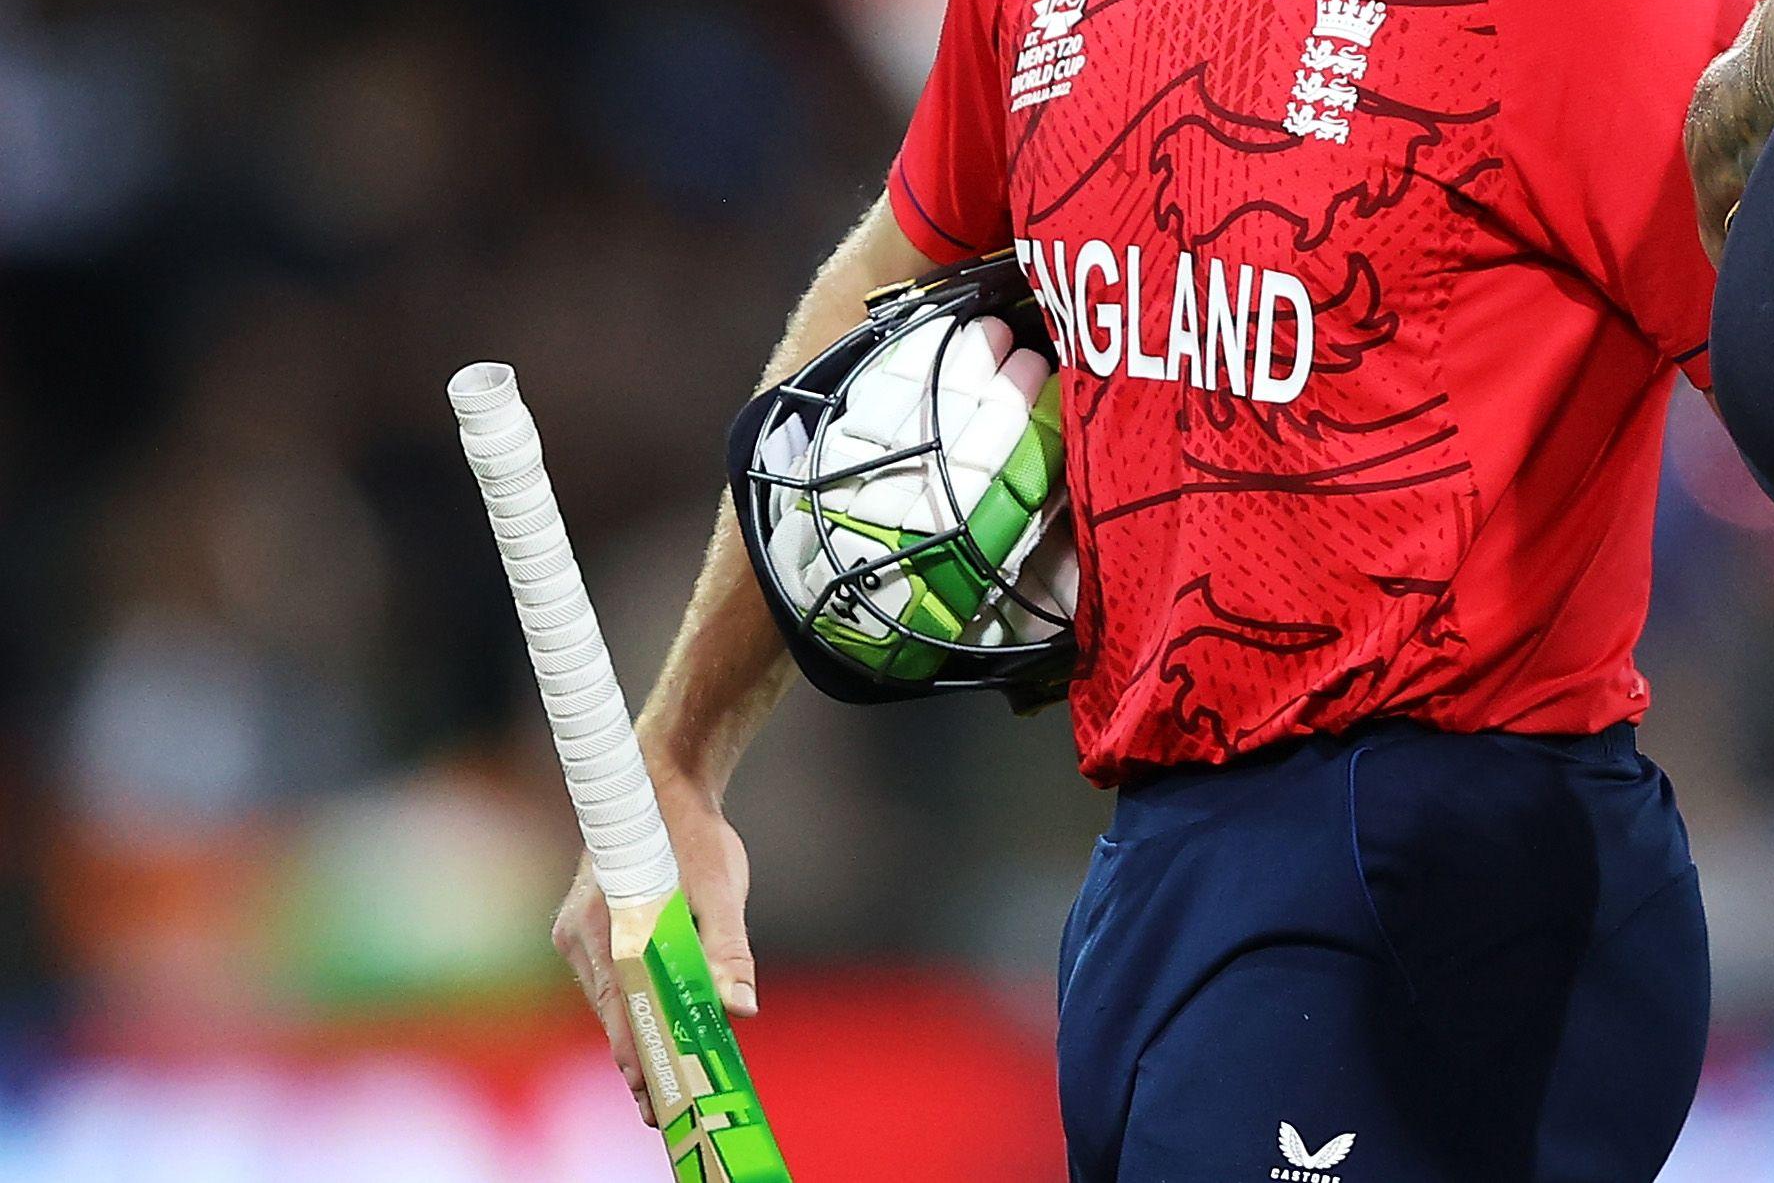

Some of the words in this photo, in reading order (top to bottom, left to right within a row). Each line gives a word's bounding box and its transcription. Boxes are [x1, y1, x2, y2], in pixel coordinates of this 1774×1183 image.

[1057, 34, 1084, 59] T20
[1011, 64, 1053, 96] WORLD
[1054, 55, 1086, 81] CUP
[628, 992, 682, 1107] KOOKABURRA
